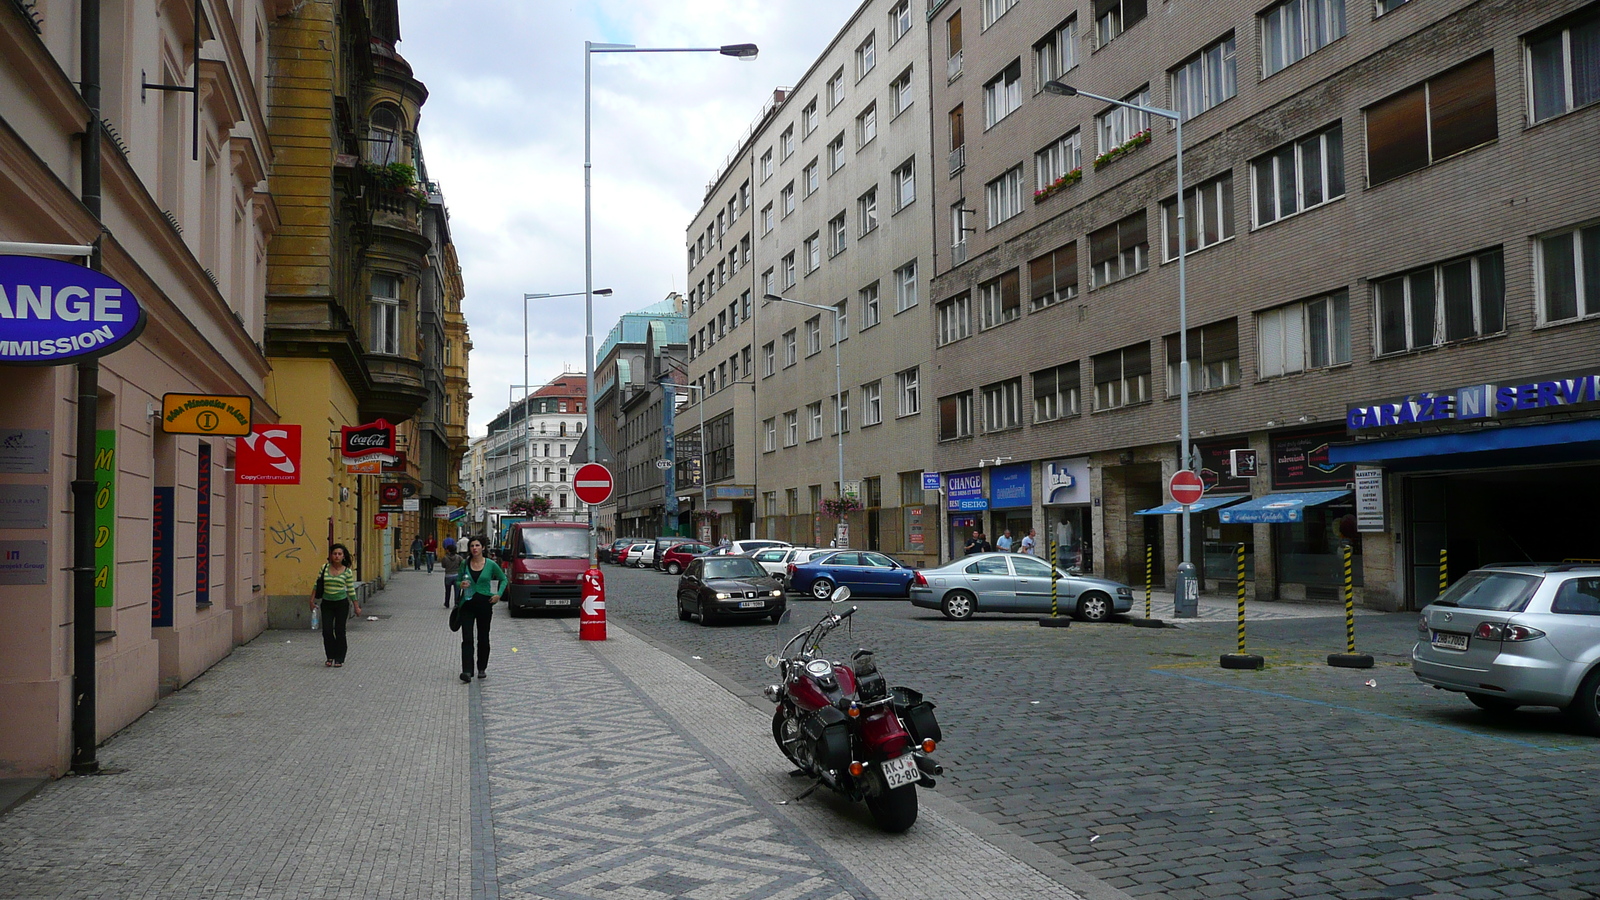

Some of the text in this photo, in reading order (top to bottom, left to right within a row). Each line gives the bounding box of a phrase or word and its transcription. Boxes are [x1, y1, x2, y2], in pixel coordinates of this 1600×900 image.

[1496, 376, 1600, 412] SERVI
[1347, 393, 1452, 430] GARÁŽE
[949, 475, 981, 490] CHANGE
[961, 501, 988, 509] SEIKO
[885, 759, 904, 775] AKJ
[889, 768, 918, 786] 32-80
